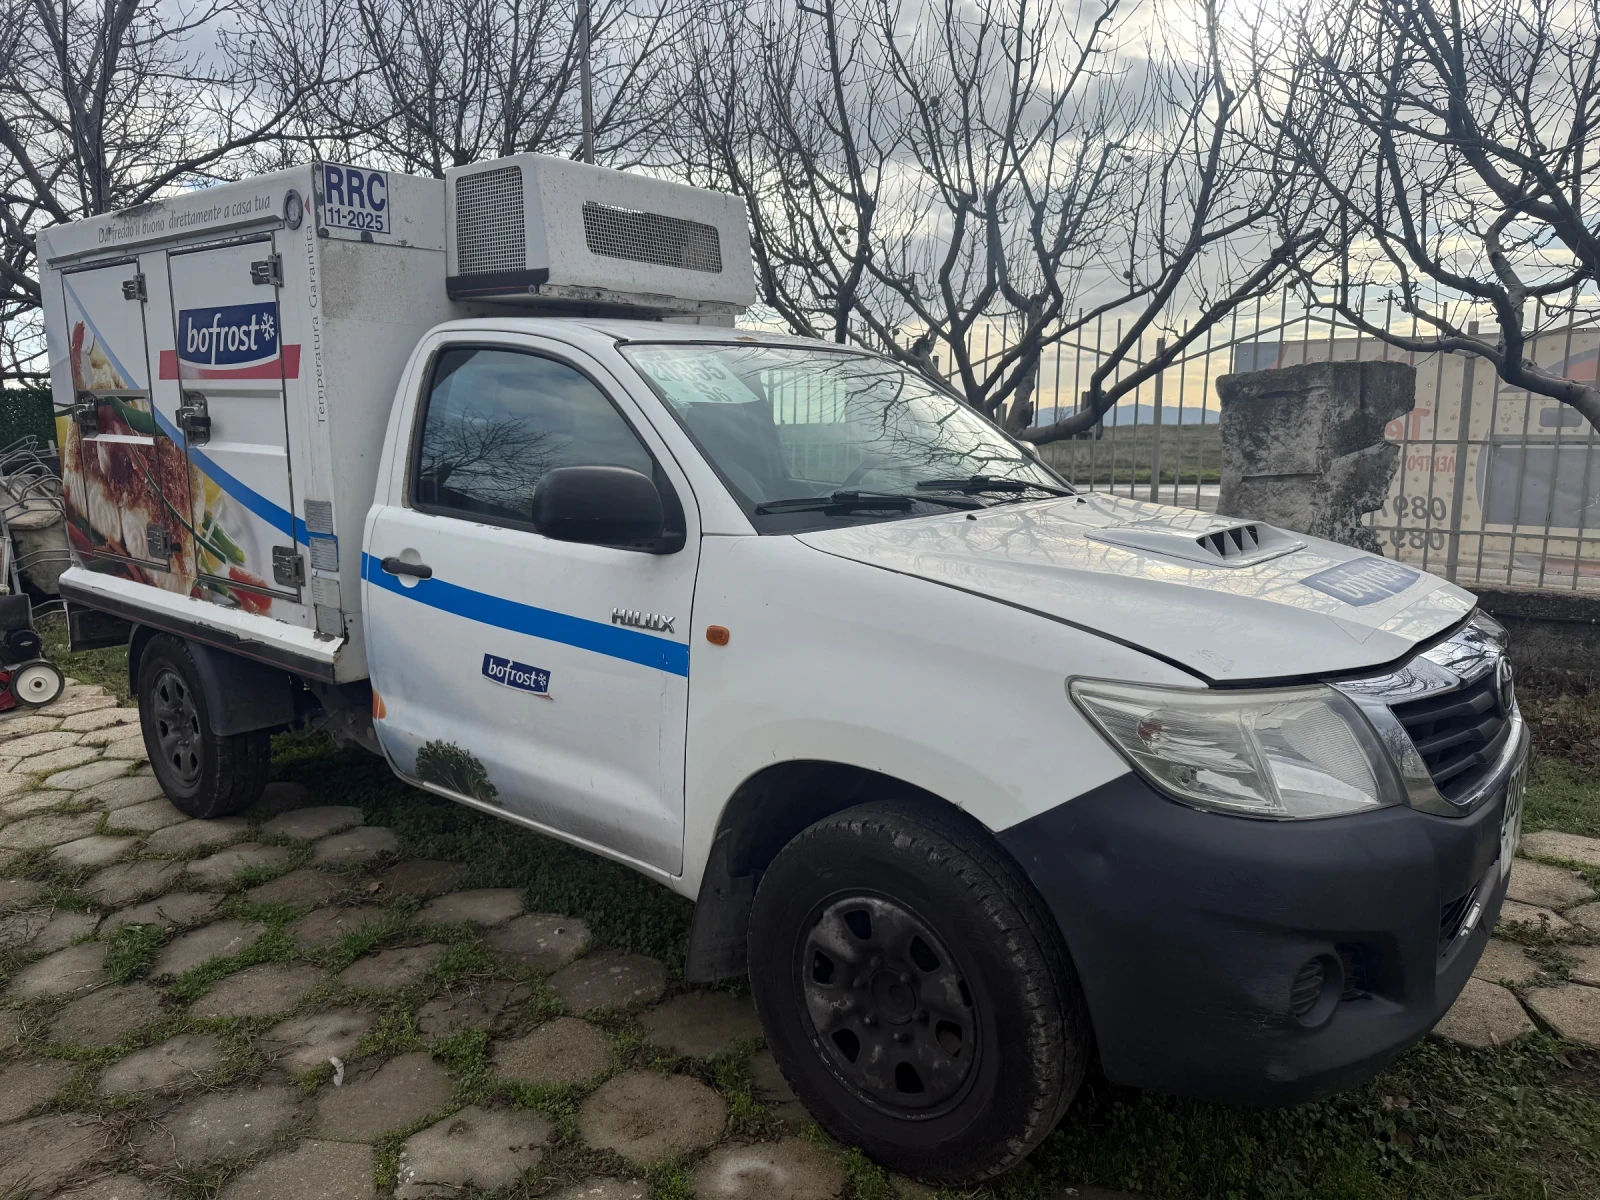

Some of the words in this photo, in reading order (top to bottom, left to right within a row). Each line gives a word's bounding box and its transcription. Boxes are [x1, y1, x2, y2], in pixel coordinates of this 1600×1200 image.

[325, 165, 386, 212] RRC
[111, 220, 133, 244] freddo
[142, 218, 164, 235] buono
[168, 205, 221, 230] direttamente
[223, 206, 230, 217] a
[232, 199, 252, 216] casa
[254, 194, 270, 212] tua
[327, 206, 384, 231] 11-2025
[304, 224, 318, 309] Garantita
[186, 312, 260, 366] bofrost
[312, 316, 326, 428] Temperatura
[611, 607, 676, 634] HILUX
[487, 658, 538, 687] bofrost
